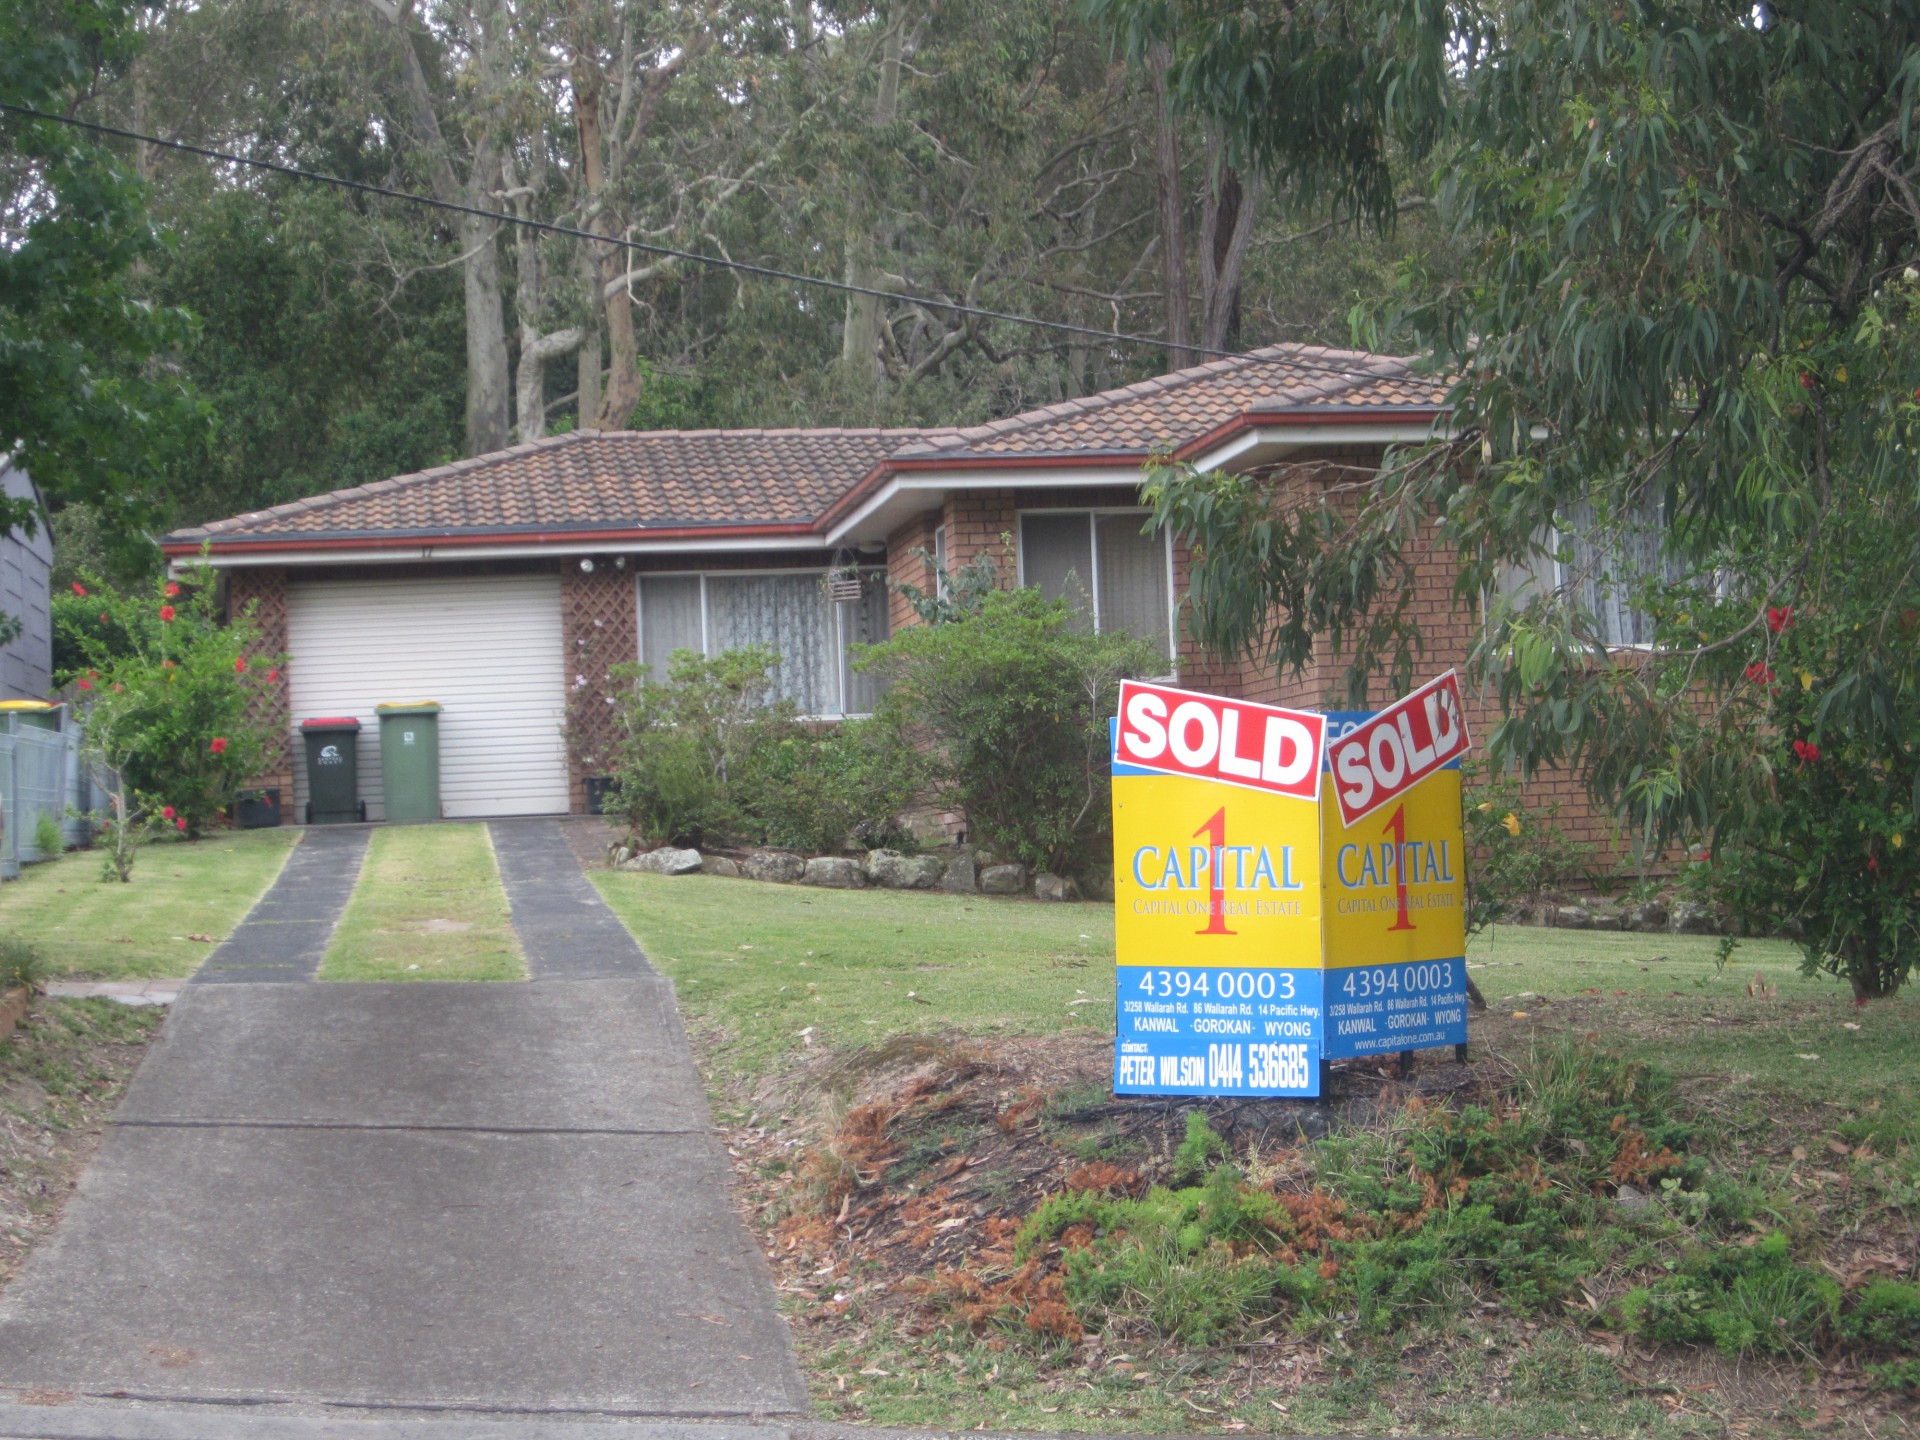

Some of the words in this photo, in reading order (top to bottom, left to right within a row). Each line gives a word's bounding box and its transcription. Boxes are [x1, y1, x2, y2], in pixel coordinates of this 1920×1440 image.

[1123, 692, 1314, 785] SOLD
[1337, 688, 1460, 810] SOLD
[1132, 845, 1303, 890] CAPITAL
[1192, 806, 1238, 935] 1
[1337, 839, 1455, 889] CAPITAL
[1382, 802, 1417, 932] 1
[1133, 899, 1182, 915] CAPITAL
[1186, 899, 1215, 915] ONE
[1220, 901, 1249, 915] REAL
[1256, 901, 1301, 915] ESTATE
[1337, 898, 1377, 914] CAPITAL
[1404, 895, 1424, 910] REAL
[1427, 893, 1454, 908] ESTATE
[1139, 970, 1210, 997] 4394
[1217, 972, 1296, 999] 0003
[1343, 968, 1399, 997] 4394
[1404, 962, 1452, 992] 0003
[1124, 1001, 1142, 1013] 3/258
[1144, 1001, 1174, 1013] Wallarah
[1176, 1002, 1189, 1014] Rd.
[1193, 1003, 1202, 1014] 86
[1204, 1003, 1238, 1015] Wallarah
[1240, 1003, 1253, 1015] Rd.
[1258, 1004, 1268, 1015] 14
[1270, 1004, 1298, 1017] Pacific
[1300, 1005, 1320, 1019] Hwy.
[1329, 1004, 1345, 1016] 3/258
[1347, 1002, 1373, 1015] Wallarah
[1374, 1002, 1384, 1013] Rd.
[1395, 997, 1418, 1010] Wallarah
[1431, 995, 1437, 1005] 14
[1437, 993, 1454, 1005] Pacific
[1134, 1017, 1179, 1033] KANWAL
[1265, 1021, 1311, 1037] WYONG
[1338, 1017, 1376, 1035] KANWAL
[1434, 1009, 1461, 1025] WYONG
[1355, 1031, 1445, 1050] www.capitalone.com.au
[1119, 1055, 1155, 1086] PETER
[1160, 1056, 1205, 1087] WILSON
[1208, 1043, 1243, 1088] 0414
[1248, 1043, 1309, 1088] 536685
